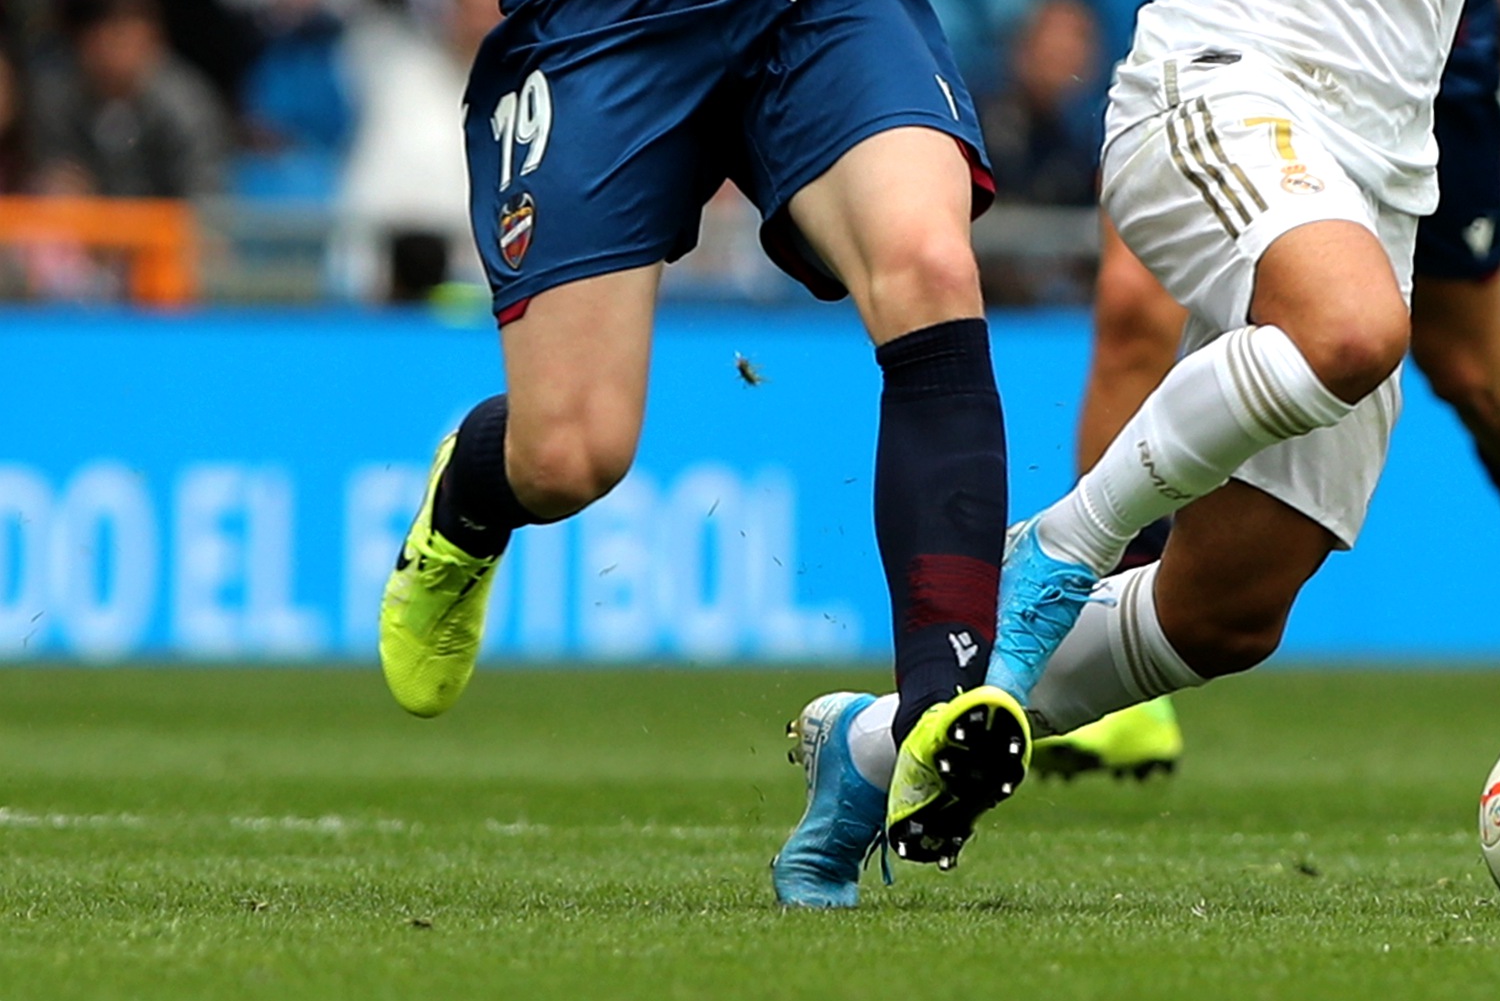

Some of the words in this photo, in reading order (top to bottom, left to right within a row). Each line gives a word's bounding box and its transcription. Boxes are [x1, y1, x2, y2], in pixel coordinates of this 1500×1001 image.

[490, 69, 552, 192] 19
[1242, 116, 1298, 160] 7
[174, 460, 330, 658] EL
